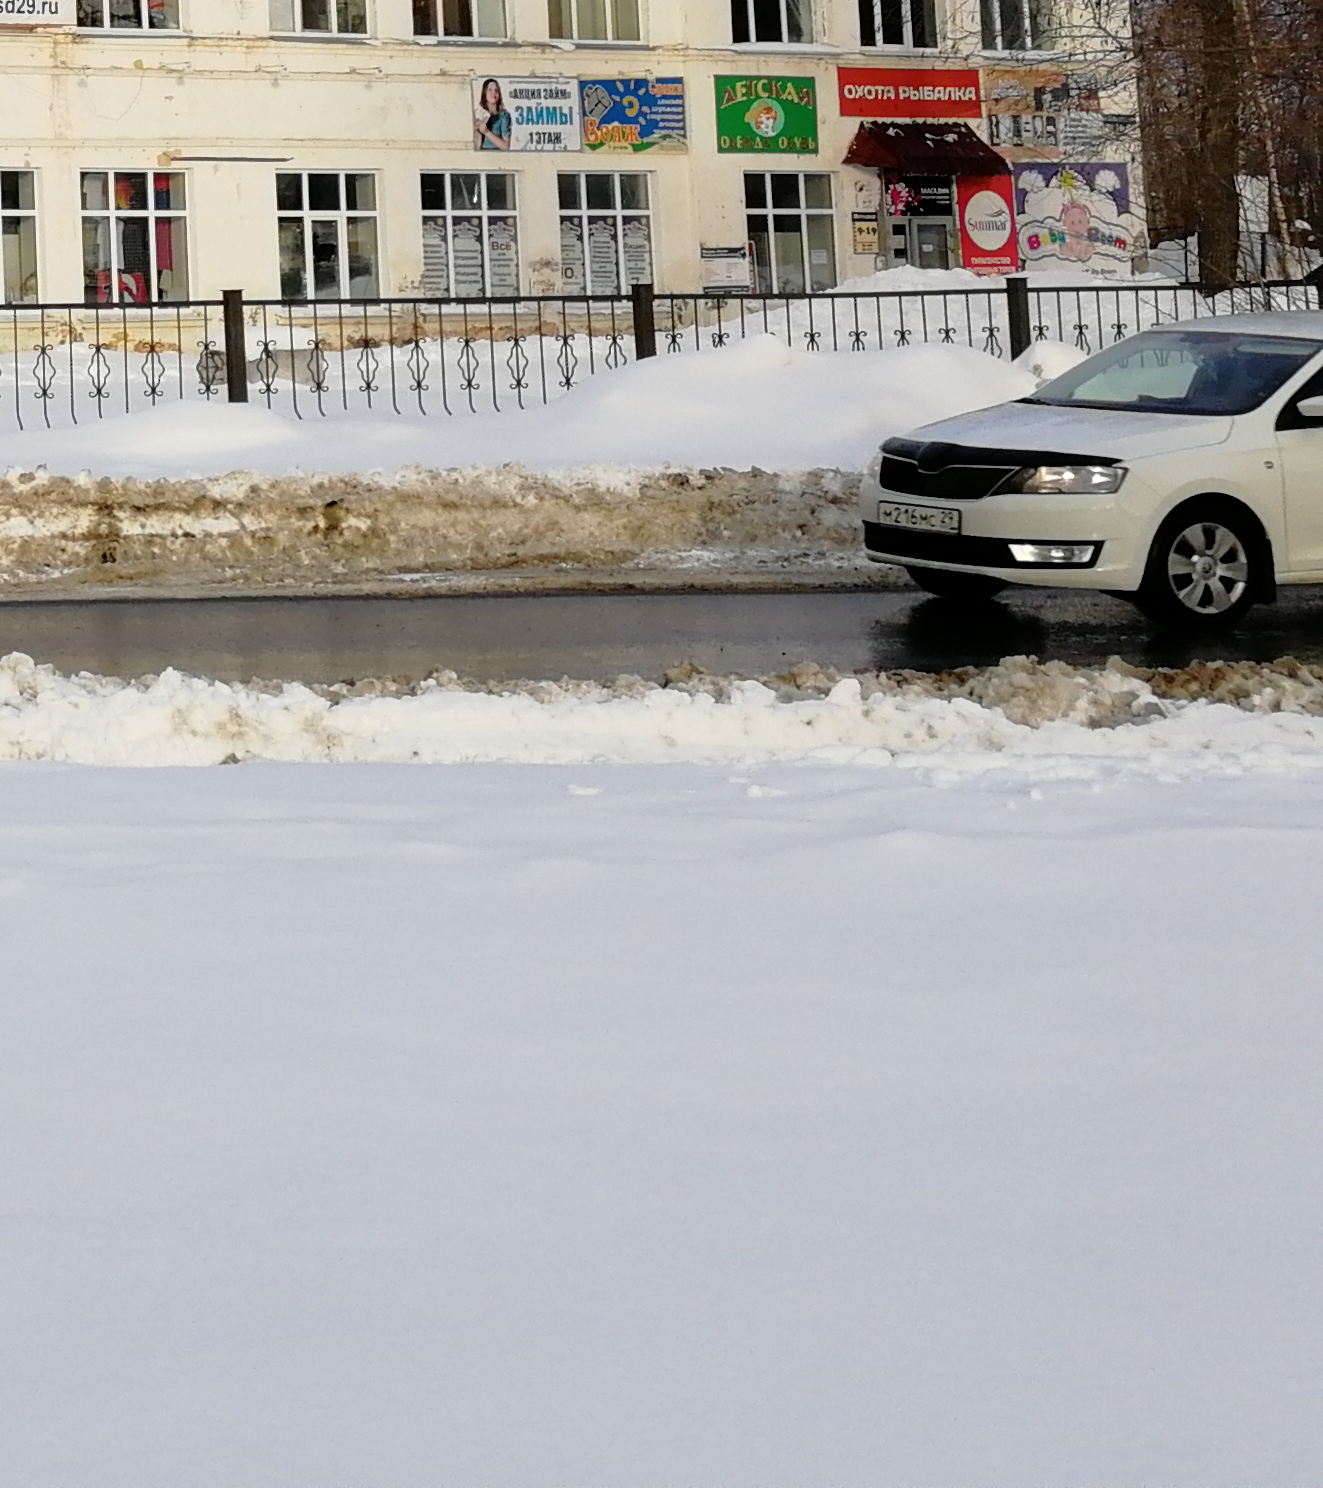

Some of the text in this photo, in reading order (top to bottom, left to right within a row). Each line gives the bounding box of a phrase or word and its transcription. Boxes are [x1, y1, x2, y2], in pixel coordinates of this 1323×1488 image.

[720, 78, 813, 110] ДЕТСКАЯ
[843, 84, 896, 100] ОХОТА
[899, 85, 977, 101] РЫБАЛКА
[515, 102, 573, 125] ЗАЙМЫ
[529, 132, 562, 144] 1 ЭТАЖ
[857, 227, 877, 236] 9-19
